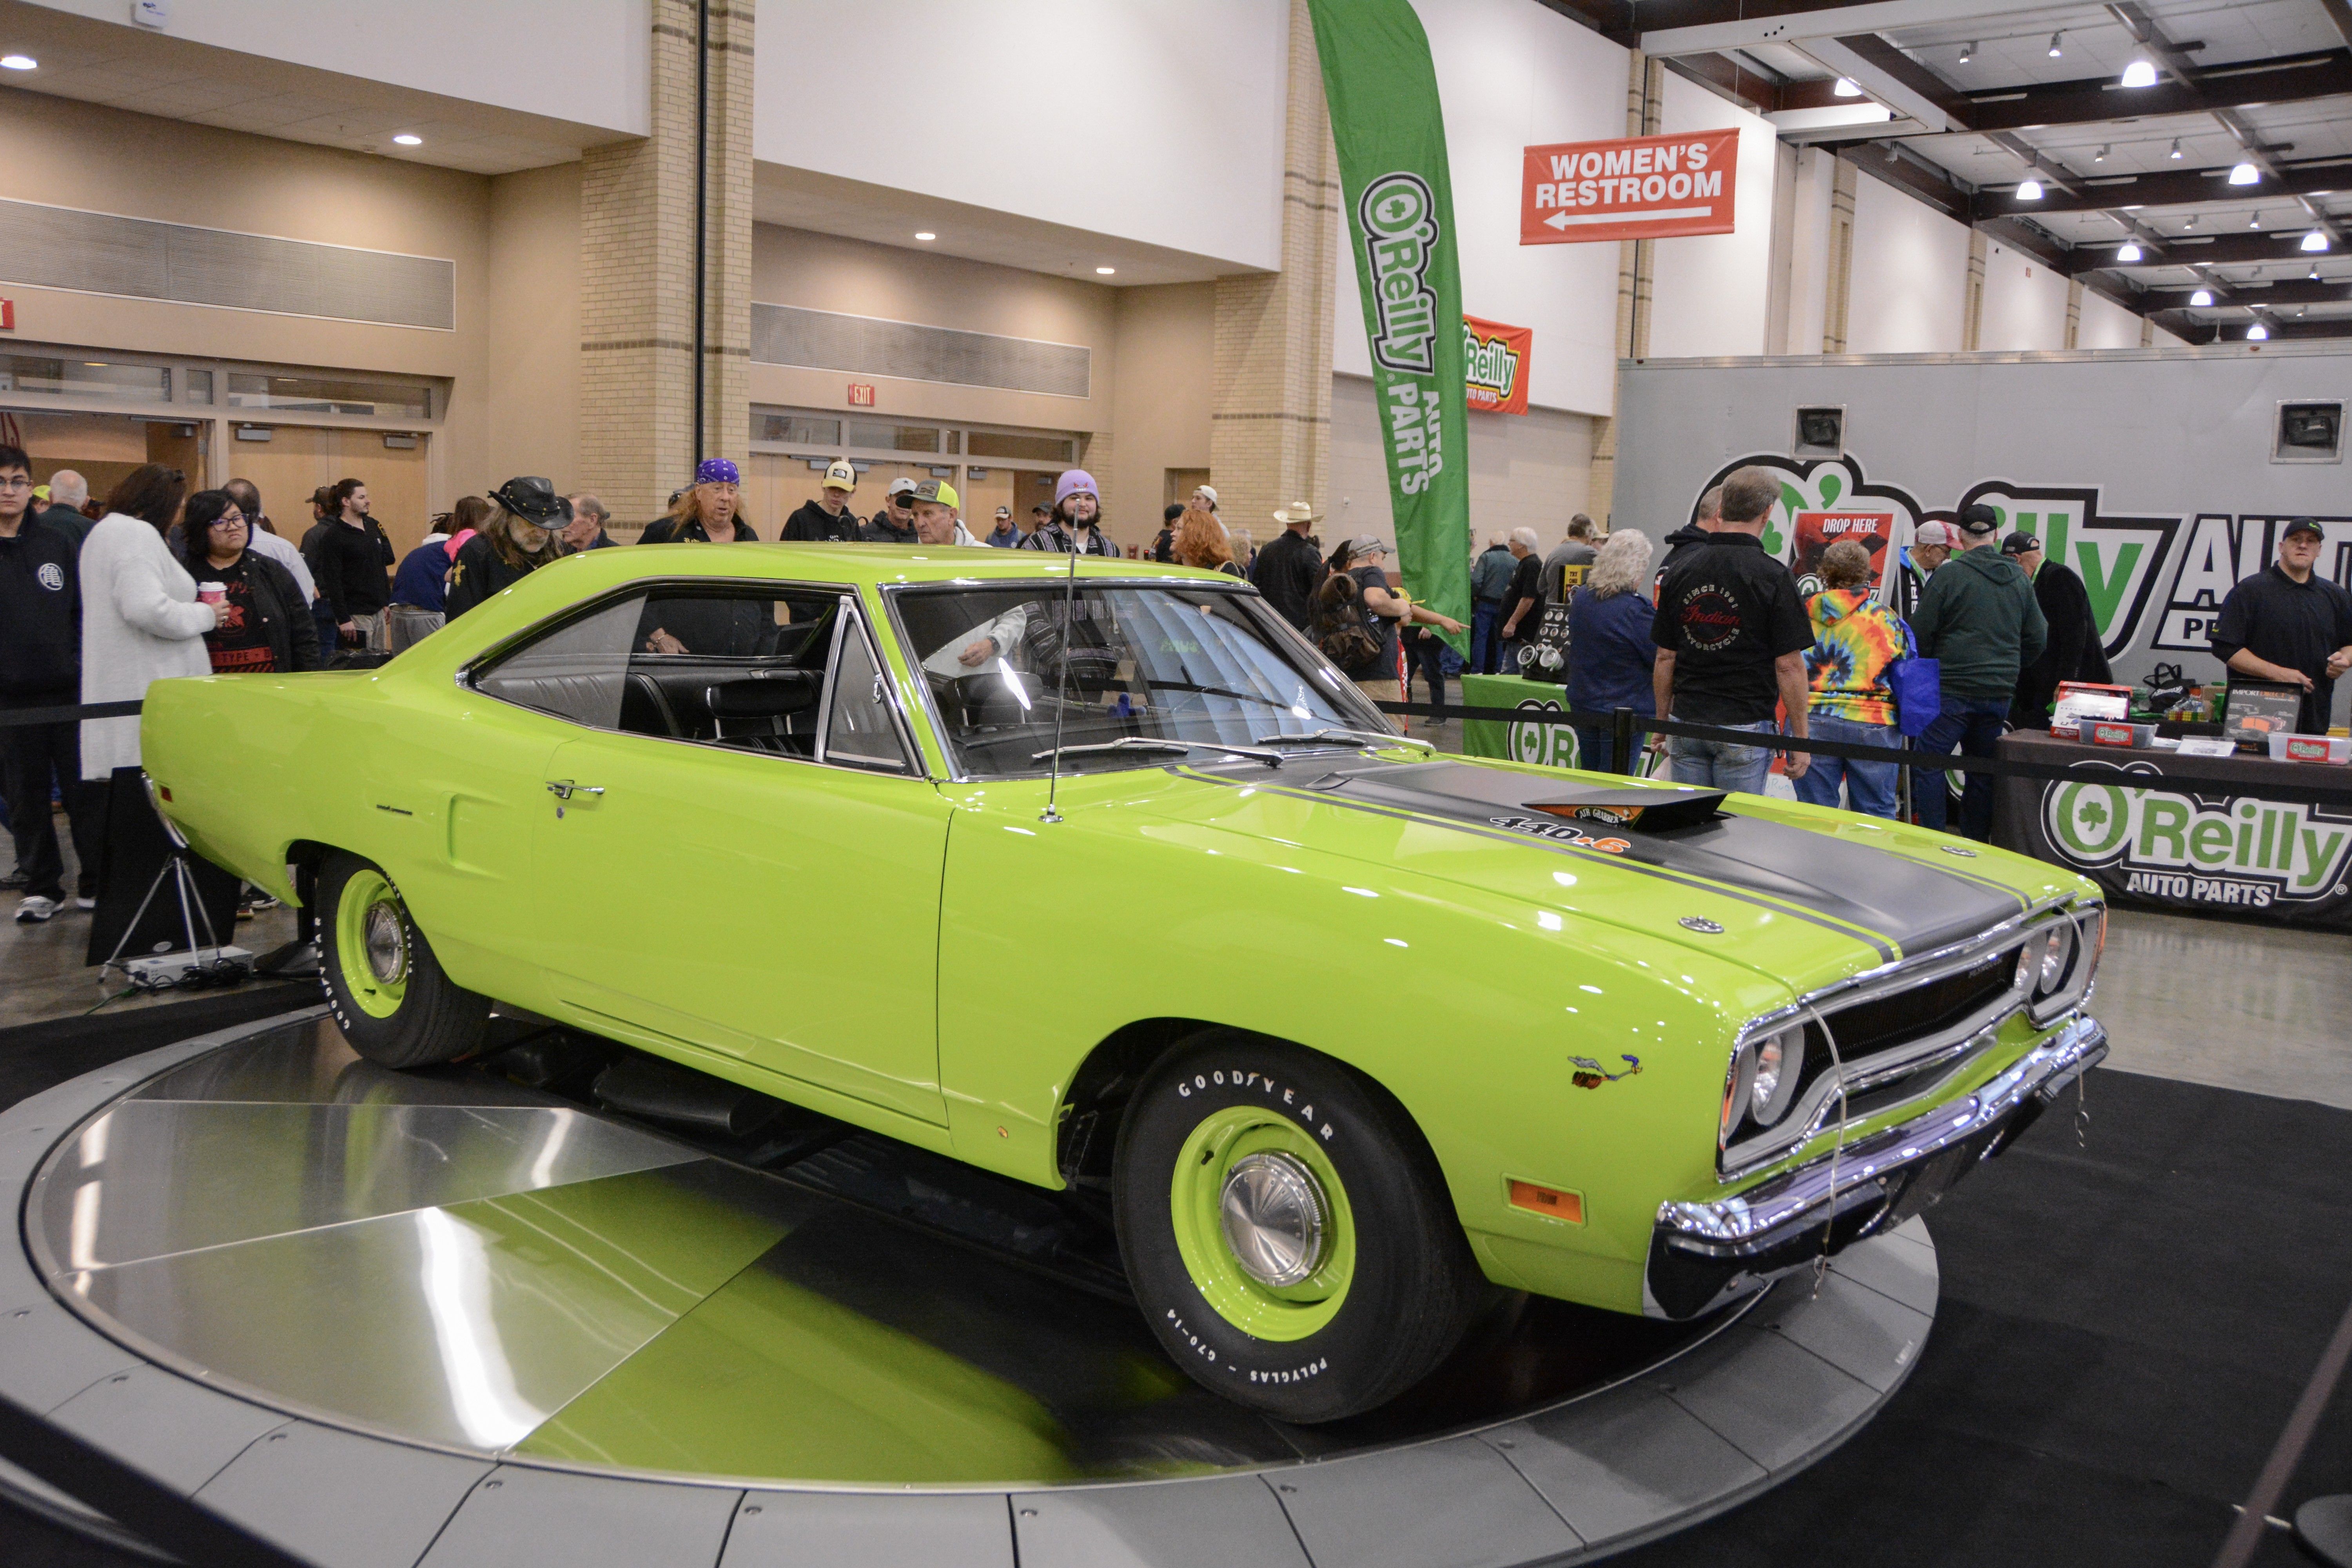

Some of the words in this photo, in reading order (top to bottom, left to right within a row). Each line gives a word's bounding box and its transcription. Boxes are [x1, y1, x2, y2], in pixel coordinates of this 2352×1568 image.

[1550, 142, 1709, 180] WOMEN'S
[1535, 170, 1722, 209] RESTROOM
[1368, 177, 1436, 372] O'Reilly
[1464, 328, 1514, 391] 'Reilly
[855, 386, 871, 405] EXIT
[1477, 390, 1497, 403] PARTS
[1388, 383, 1430, 495] PARTS
[1423, 390, 1443, 478] AUTO
[1823, 518, 1850, 533] DROP
[1851, 518, 1878, 533] HERE
[1683, 584, 1715, 604] SINCE
[1720, 587, 1738, 608] 1901
[1682, 624, 1740, 650] MOTORCYCLE
[1580, 808, 1591, 819] AIR
[1593, 809, 1619, 824] GRABBER
[2126, 872, 2190, 897] AUTO
[2193, 879, 2272, 907] PARTS
[1179, 1070, 1333, 1141] GOODYEAR
[1167, 1308, 1216, 1361] G70-14
[1249, 1357, 1328, 1384] POLYGLAS
